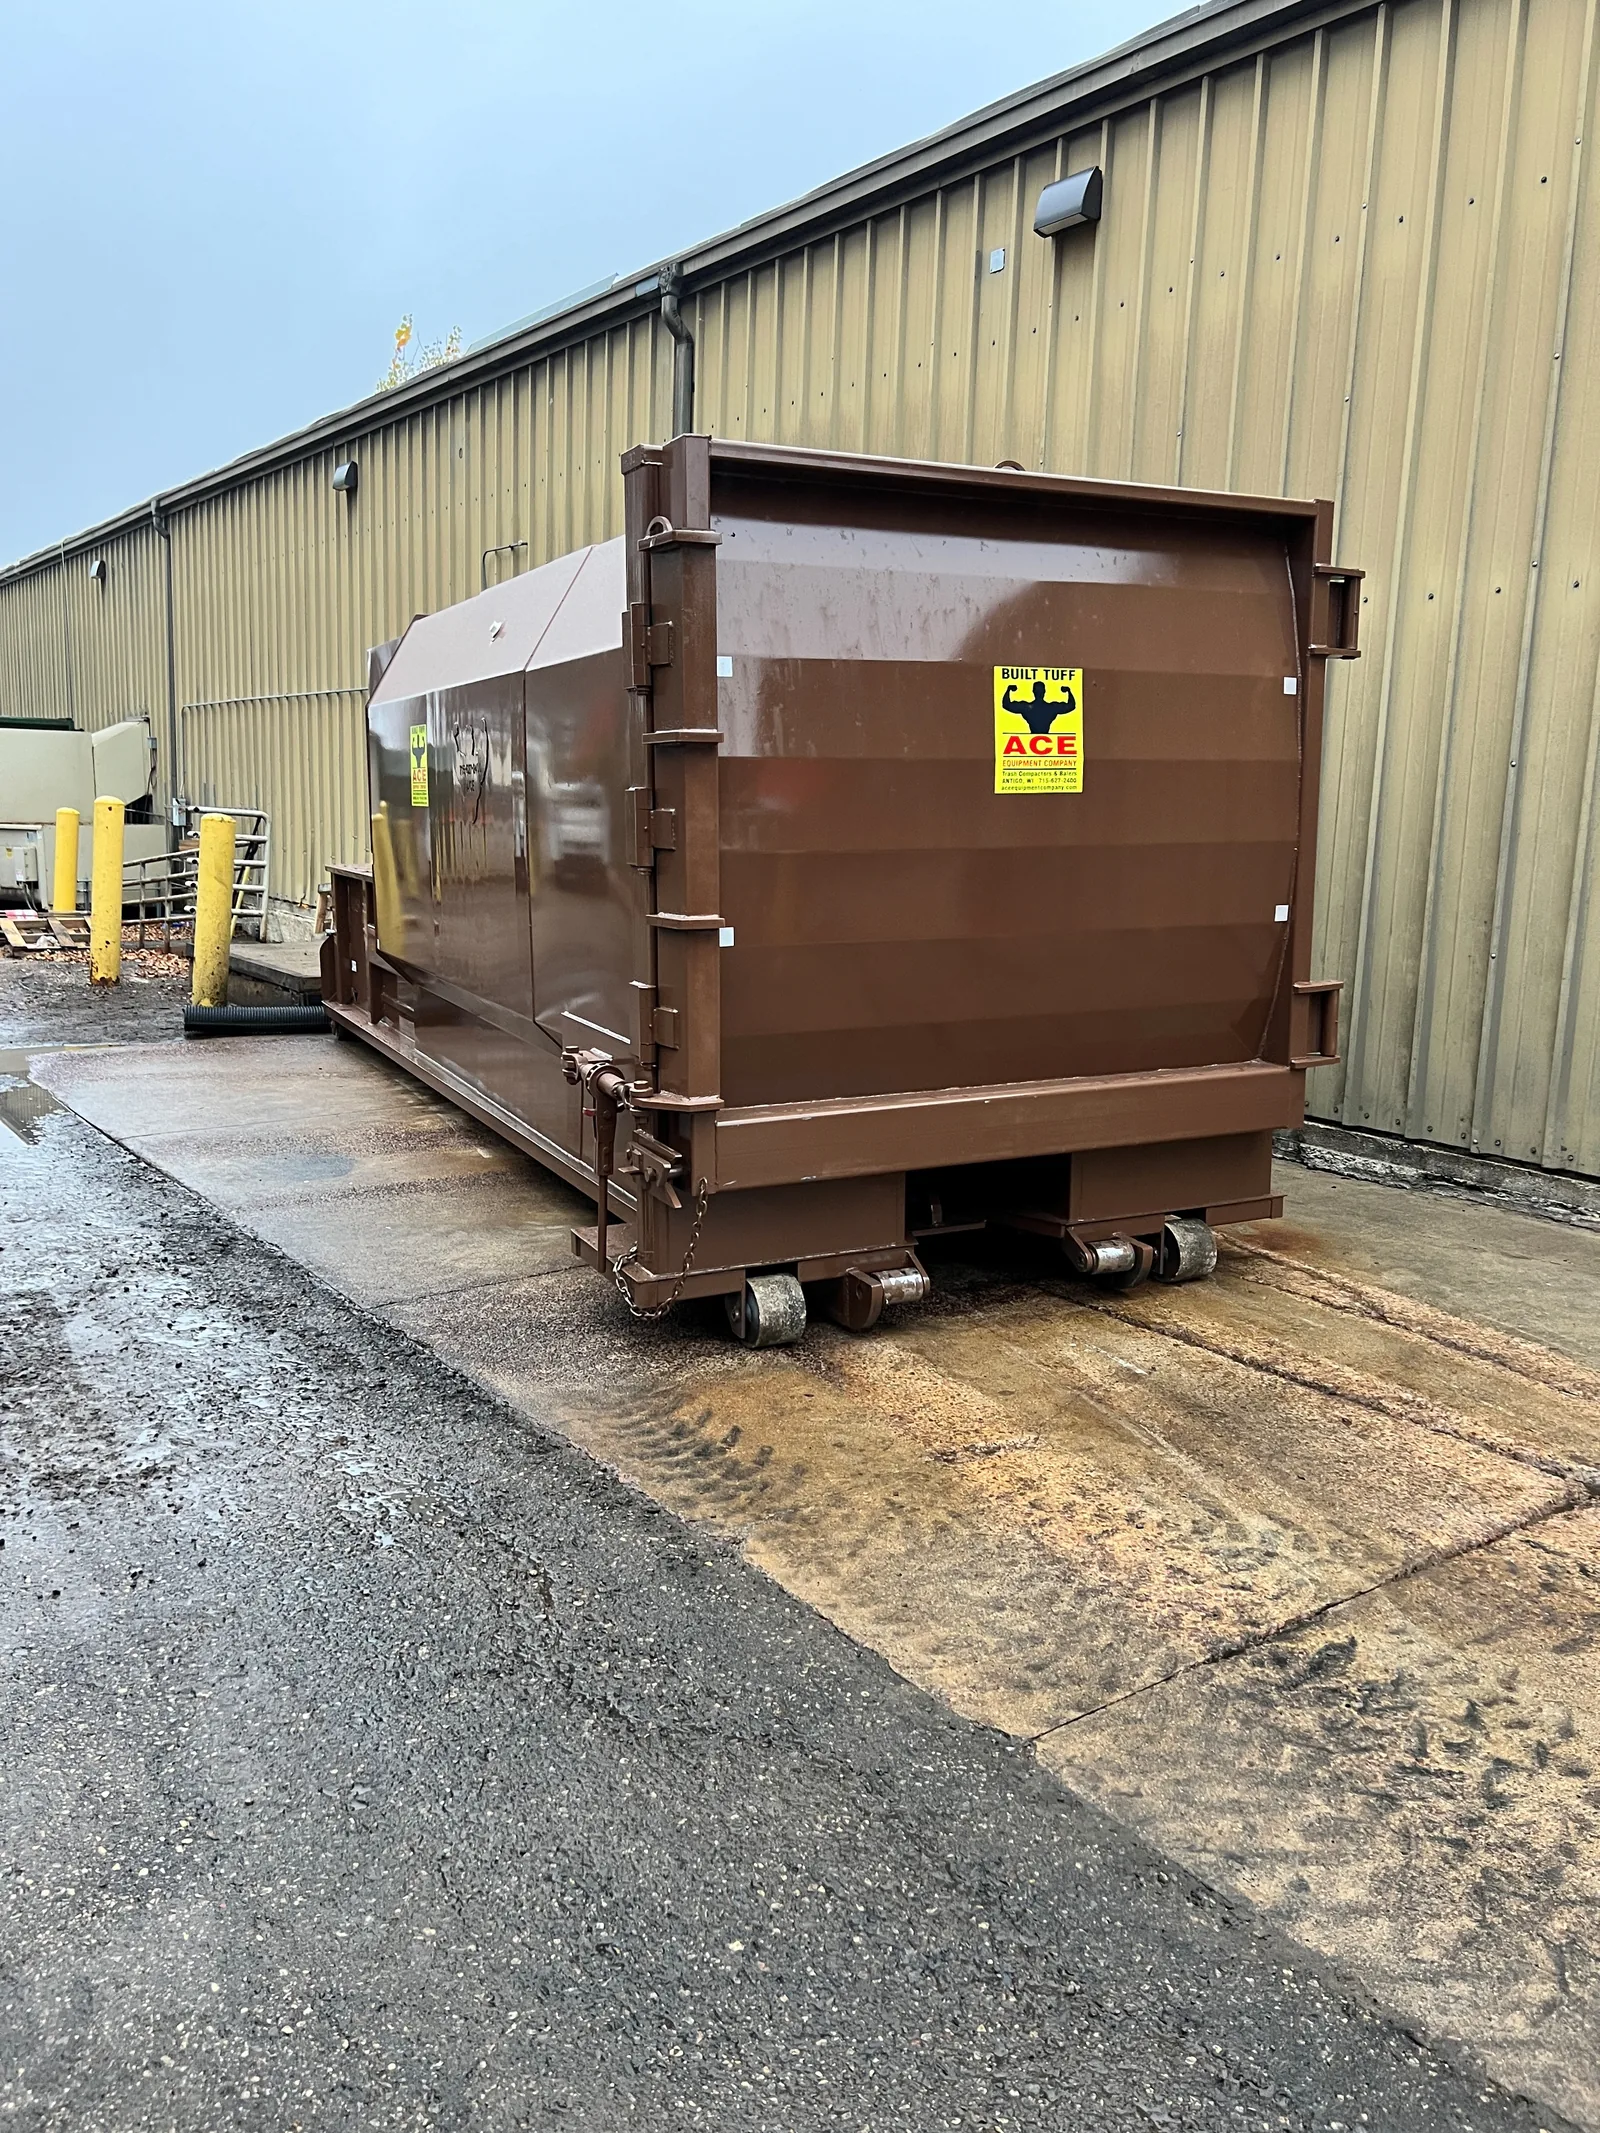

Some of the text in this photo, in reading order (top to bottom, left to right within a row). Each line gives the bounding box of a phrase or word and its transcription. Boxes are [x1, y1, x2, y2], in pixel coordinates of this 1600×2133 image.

[1002, 668, 1076, 681] BUILT TUFF
[1003, 736, 1077, 755] ACE
[1002, 759, 1077, 767] EQUIPMENT COMPANY
[413, 769, 426, 782] ACE
